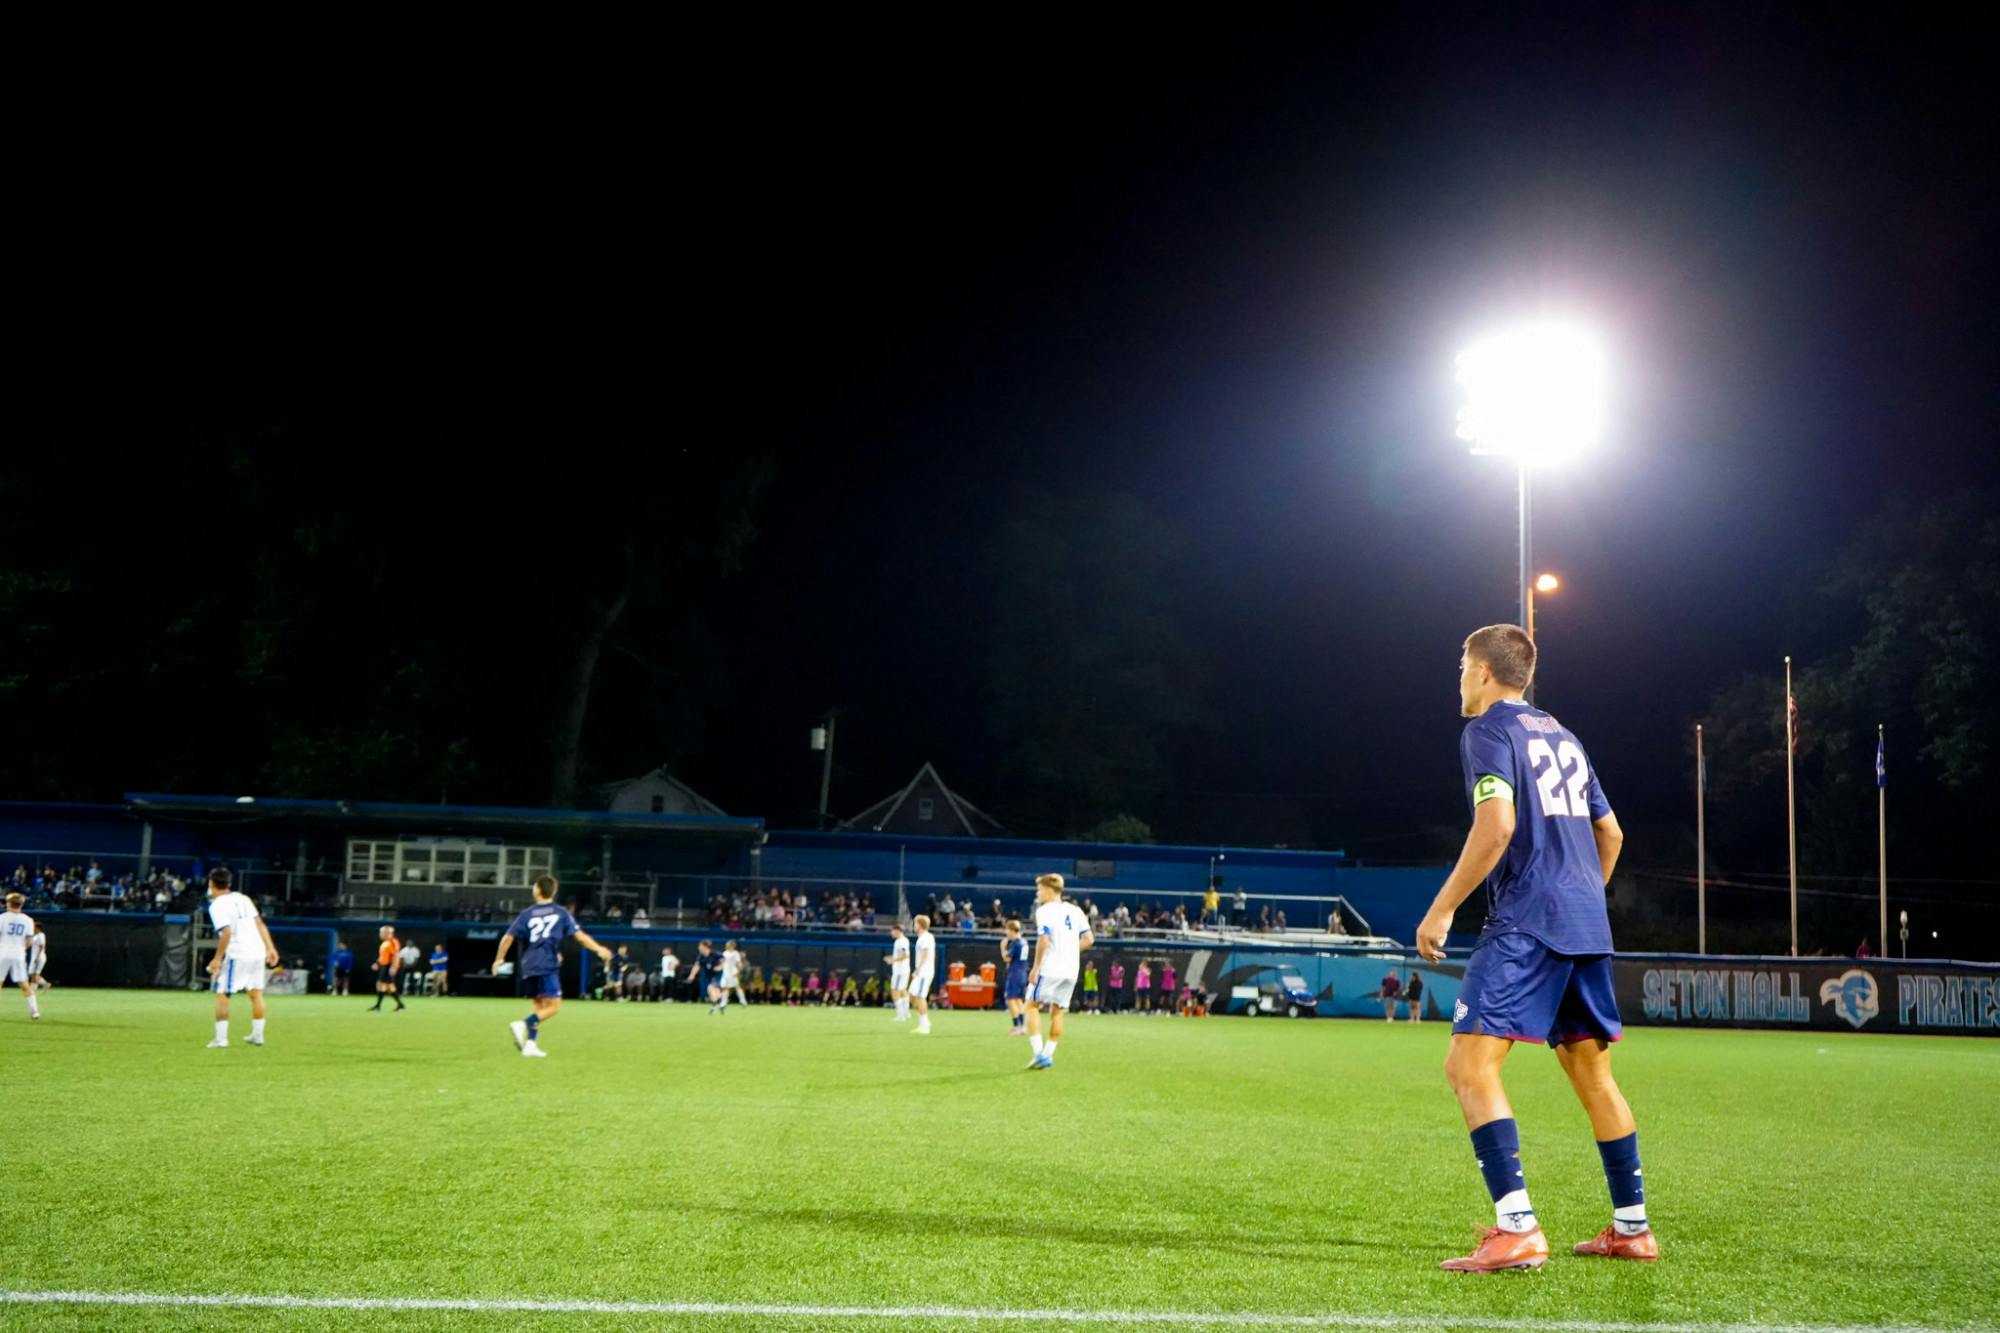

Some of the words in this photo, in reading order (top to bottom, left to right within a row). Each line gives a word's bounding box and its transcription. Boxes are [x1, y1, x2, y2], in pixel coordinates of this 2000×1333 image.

[1479, 777, 1495, 797] C
[1527, 738, 1591, 816] 22
[7, 922, 25, 936] 30
[527, 914, 560, 943] 27
[1064, 914, 1073, 931] 4
[1642, 969, 1729, 1021] SETON
[1732, 971, 1811, 1023] HALL
